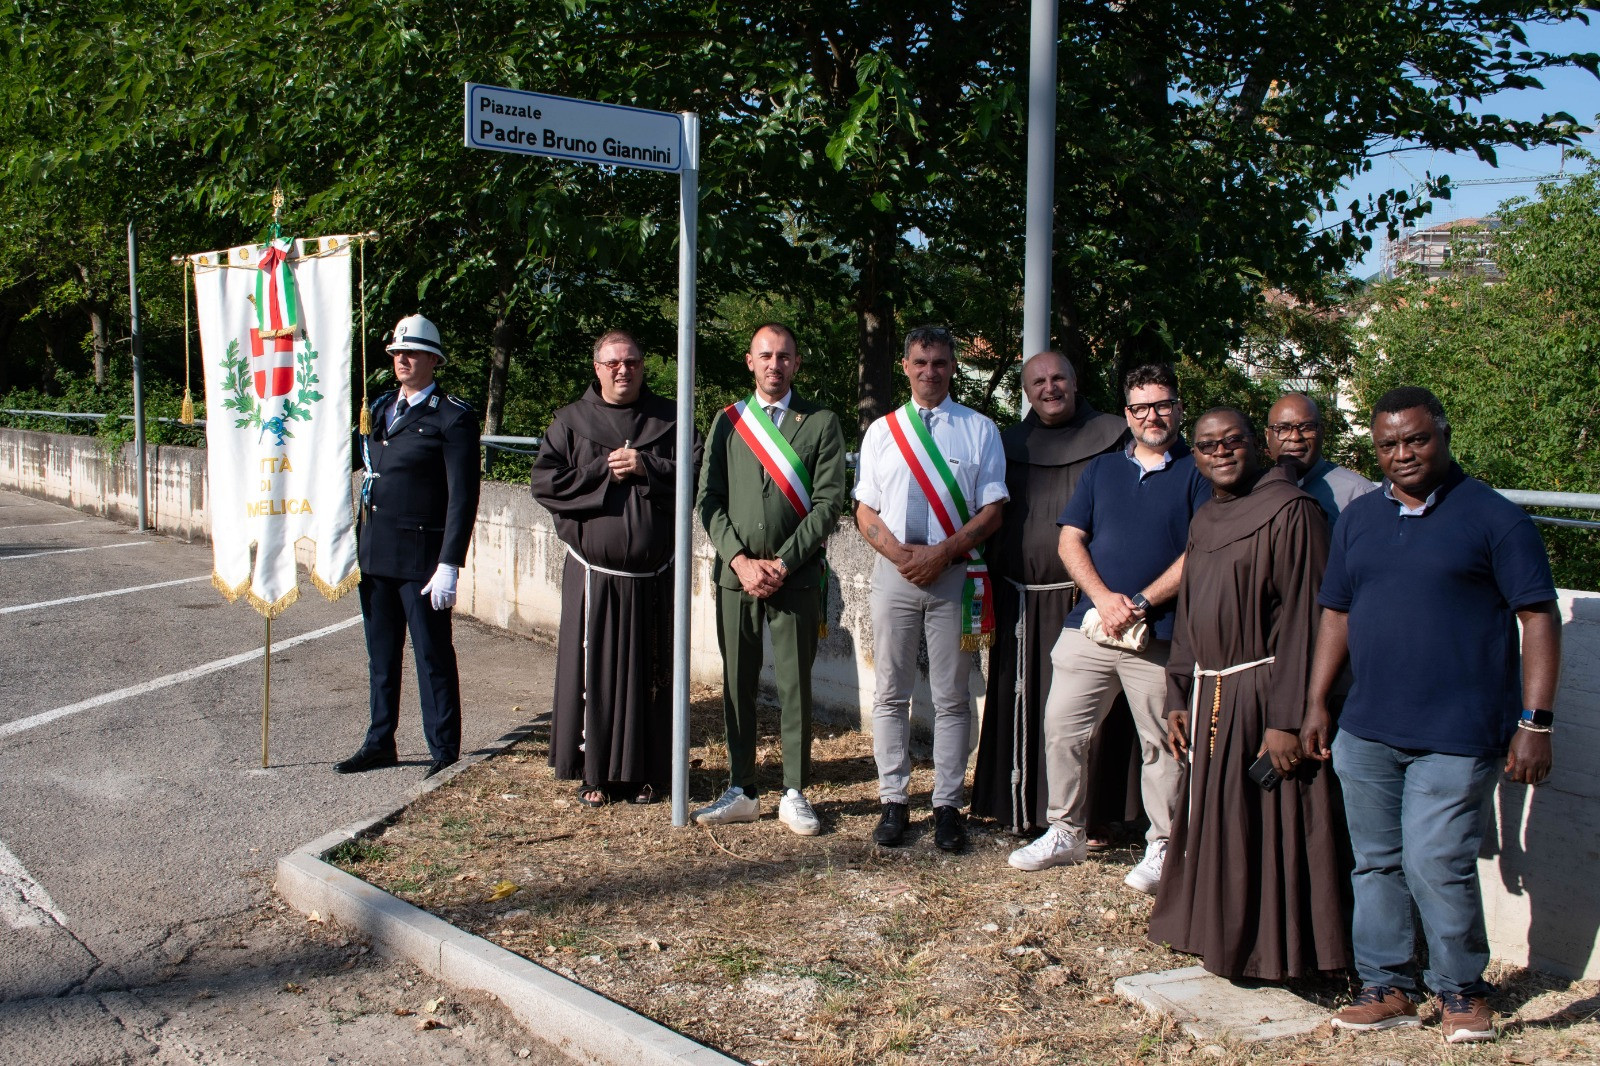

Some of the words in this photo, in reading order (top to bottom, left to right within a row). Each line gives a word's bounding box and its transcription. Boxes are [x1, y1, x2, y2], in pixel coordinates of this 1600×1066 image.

[480, 96, 542, 120] Piazzale
[480, 119, 538, 146] Padre
[542, 128, 597, 154] Bruno
[602, 137, 671, 164] Giannini
